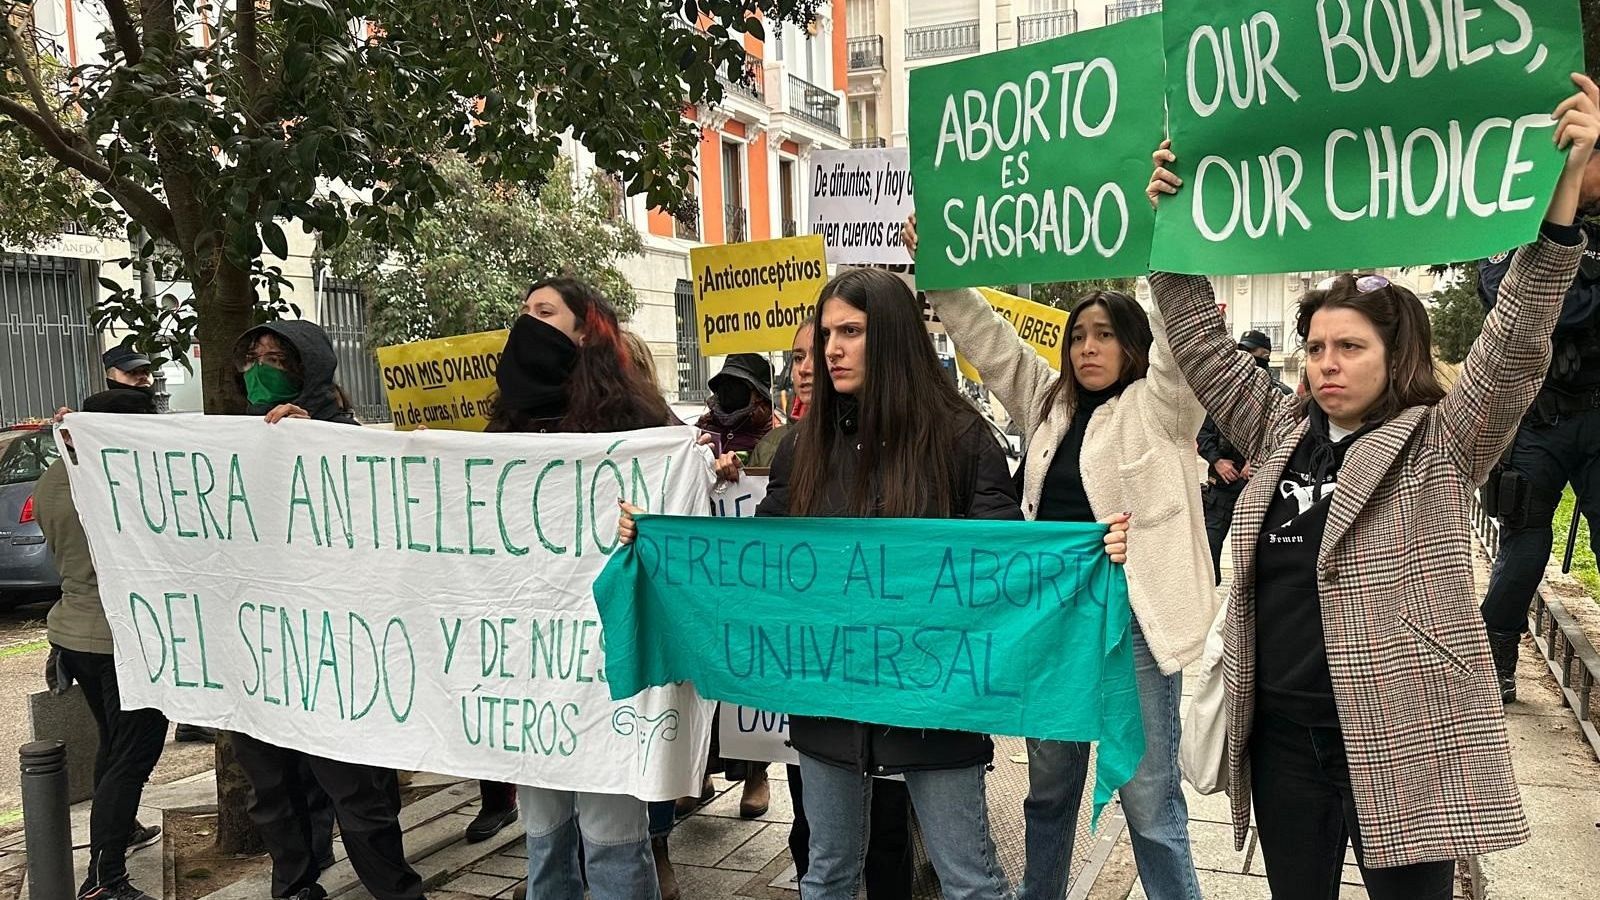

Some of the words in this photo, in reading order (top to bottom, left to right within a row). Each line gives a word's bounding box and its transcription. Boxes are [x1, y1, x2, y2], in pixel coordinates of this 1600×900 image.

[1187, 12, 1300, 117] OUR
[1316, 0, 1548, 93] BODIES,
[935, 57, 1118, 169] ABORTO
[814, 164, 827, 197] De
[829, 162, 872, 203] difuntos,
[874, 170, 883, 205] y
[884, 162, 905, 205] hoy
[1001, 151, 1029, 189] ES
[1191, 146, 1311, 242] OUR
[1325, 113, 1559, 221] CHOICE
[813, 214, 840, 247] viven
[842, 221, 884, 247] cuervos
[943, 182, 1128, 266] SAGRADO
[698, 255, 821, 301] ¡Anticonceptivos
[704, 313, 740, 343] para
[744, 311, 761, 330] no
[384, 363, 417, 390] SON
[416, 359, 443, 386] MIS
[393, 403, 406, 427] ni
[407, 401, 422, 425] de
[423, 403, 453, 424] curas,
[460, 395, 476, 419] de
[101, 447, 259, 542] FUERA
[286, 439, 672, 557] ANTIELECCIÓN
[637, 533, 818, 593] DERECHO
[842, 540, 904, 602] AL
[1268, 533, 1304, 544] Femen
[129, 591, 224, 690] DEL
[237, 601, 416, 724] SENADO
[439, 617, 462, 676] Y
[480, 618, 517, 678] DE
[722, 621, 1022, 699] UNIVERSAL
[461, 684, 580, 757] ÚTEROS
